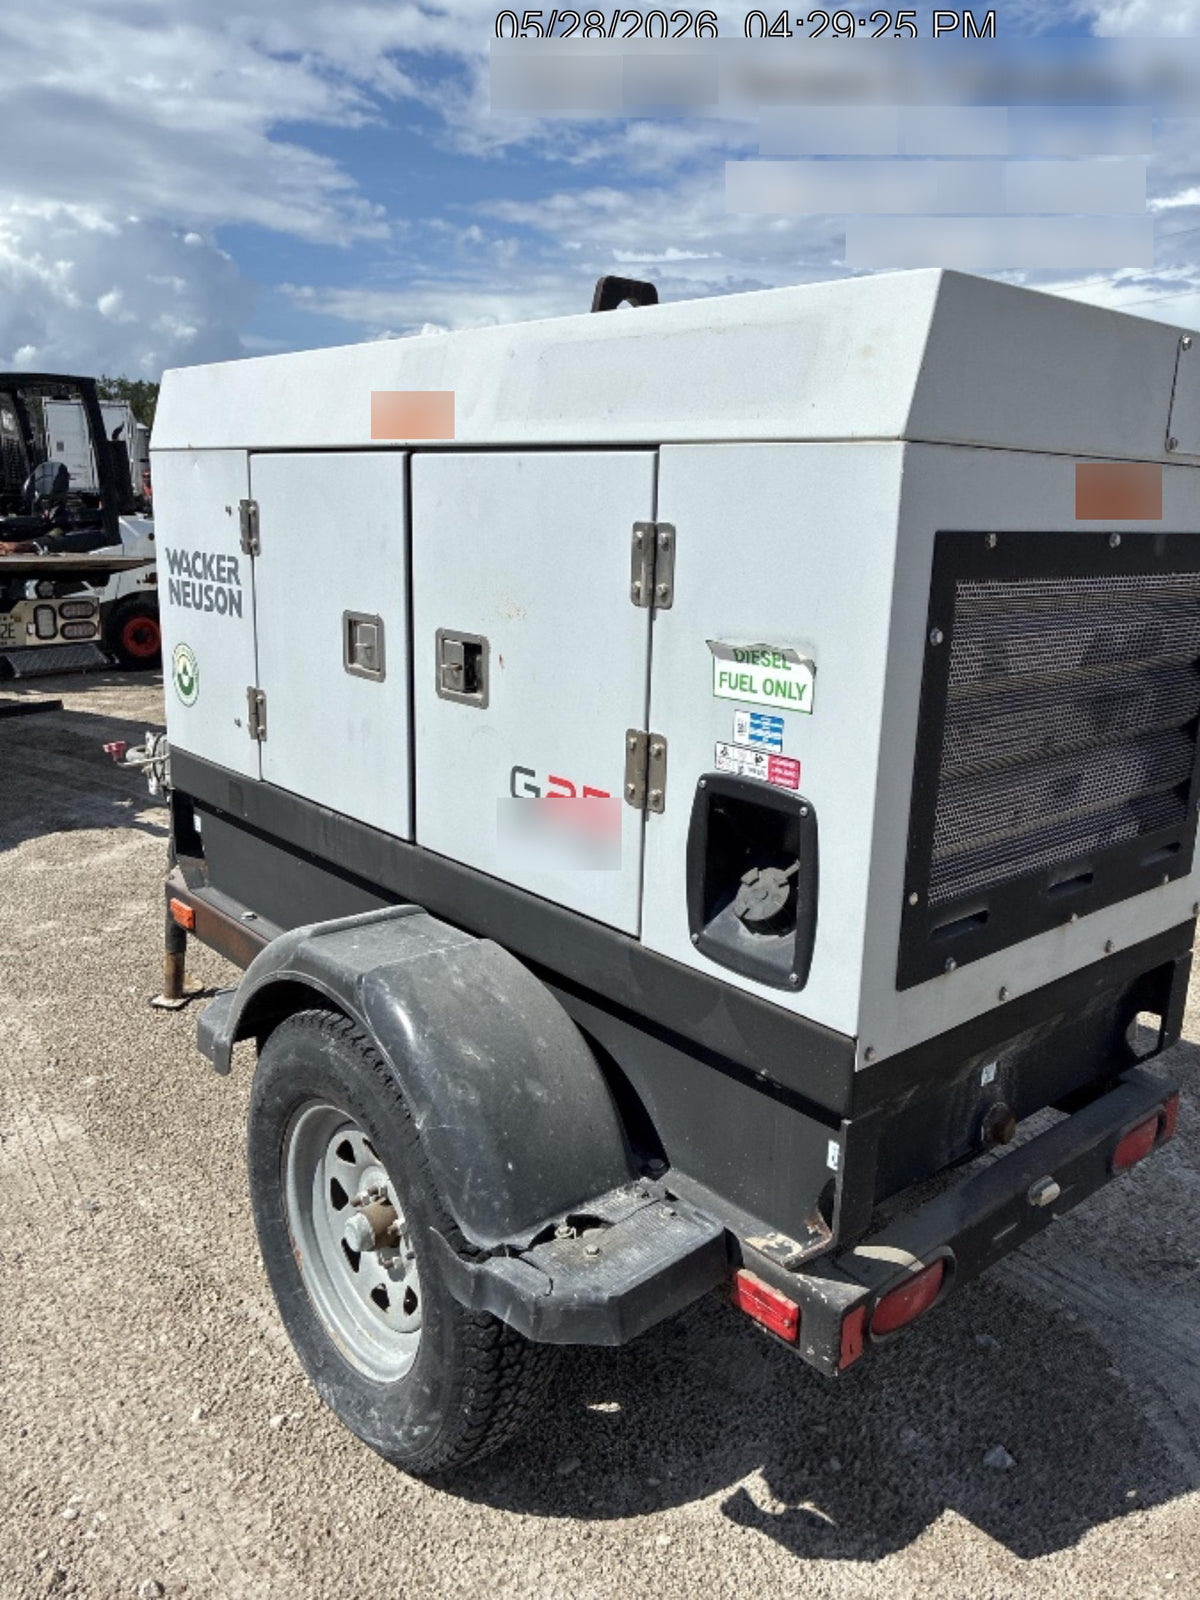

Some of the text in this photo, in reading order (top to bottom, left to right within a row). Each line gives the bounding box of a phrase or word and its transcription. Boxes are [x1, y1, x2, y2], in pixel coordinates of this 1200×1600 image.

[165, 547, 241, 587] WACKER
[168, 577, 243, 619] NEUSON
[732, 647, 792, 671] DIESEL
[719, 671, 808, 701] FUEL ONLY
